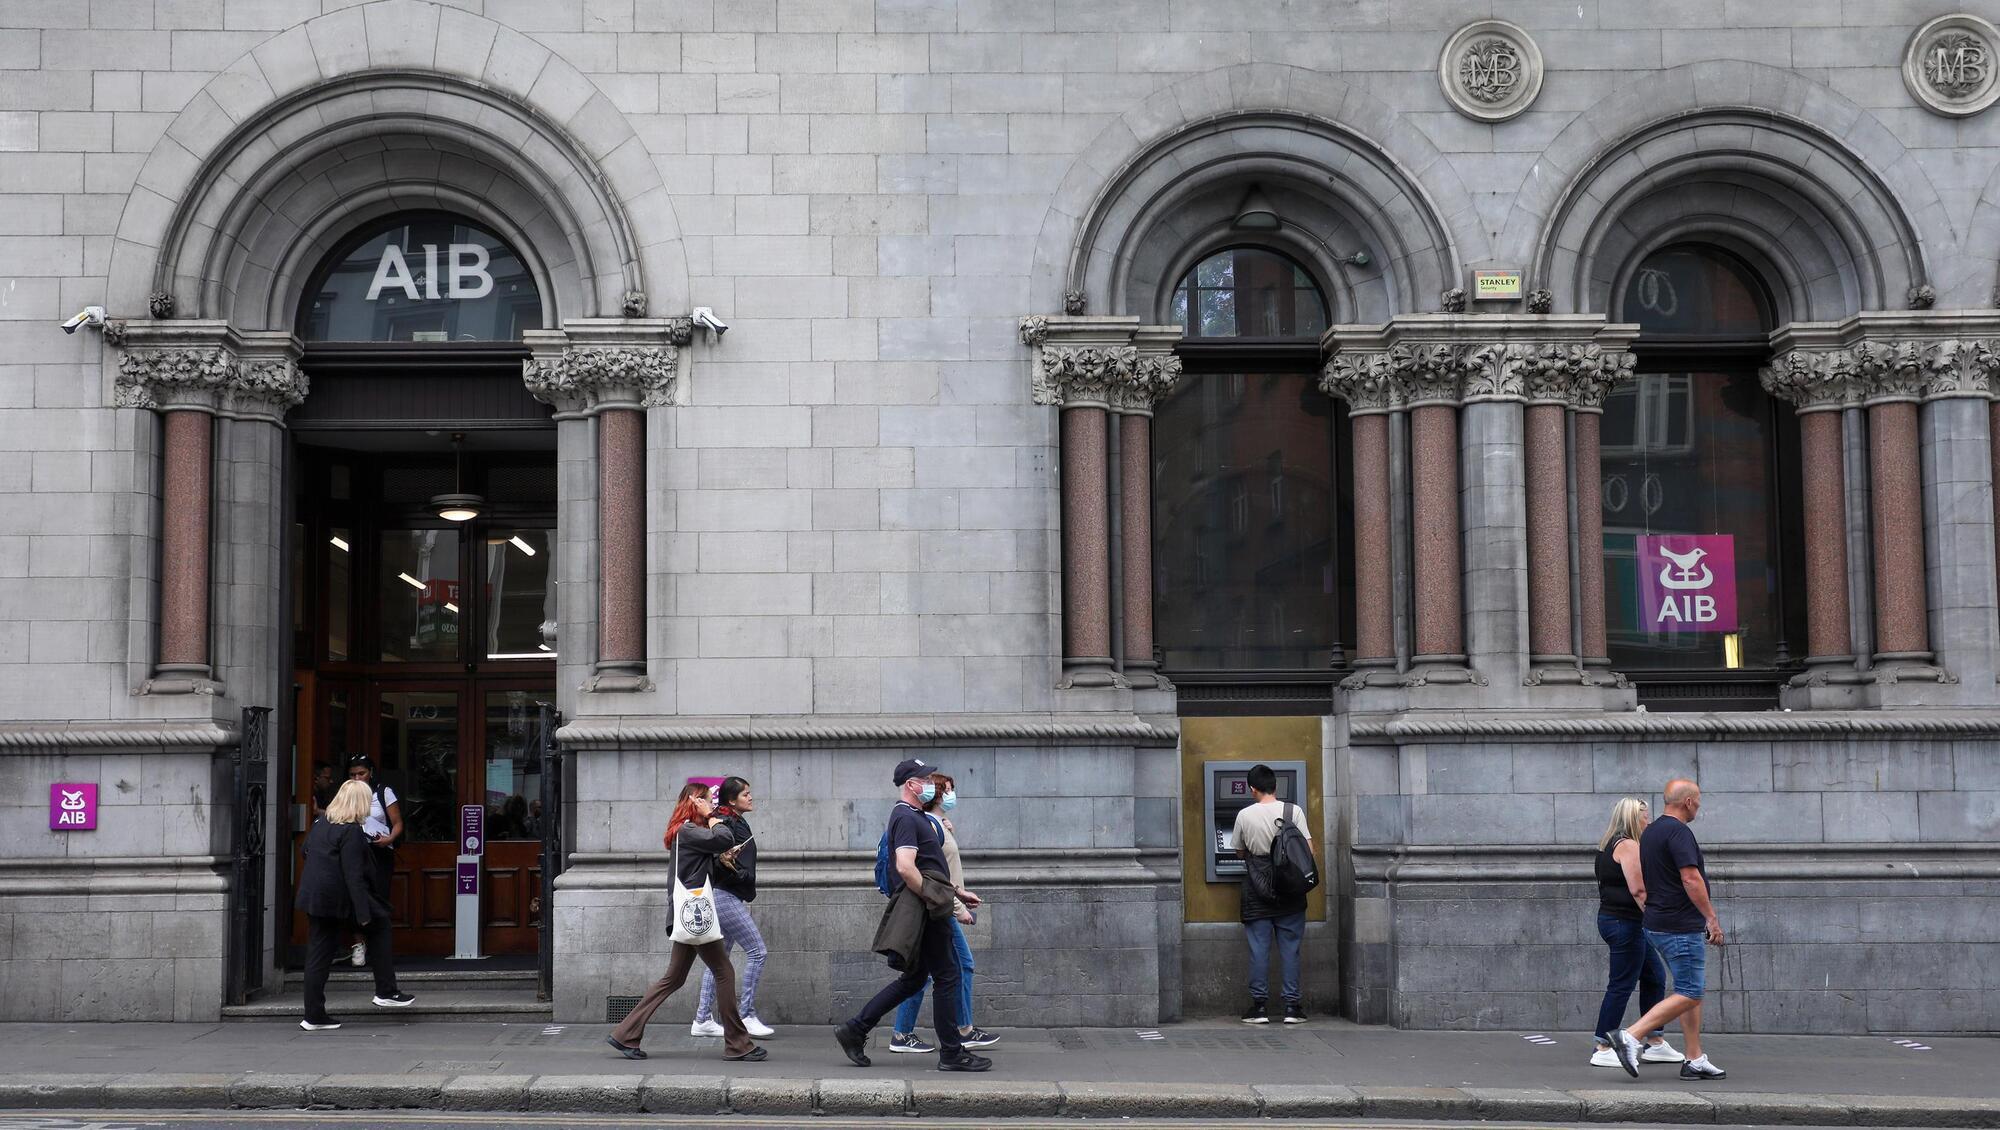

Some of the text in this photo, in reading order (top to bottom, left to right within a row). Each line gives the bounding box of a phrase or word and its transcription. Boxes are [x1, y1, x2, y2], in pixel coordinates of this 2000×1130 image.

[1936, 47, 1985, 84] MB
[365, 243, 494, 300] AIB
[1657, 595, 1717, 622] AIB
[59, 811, 86, 824] AIB
